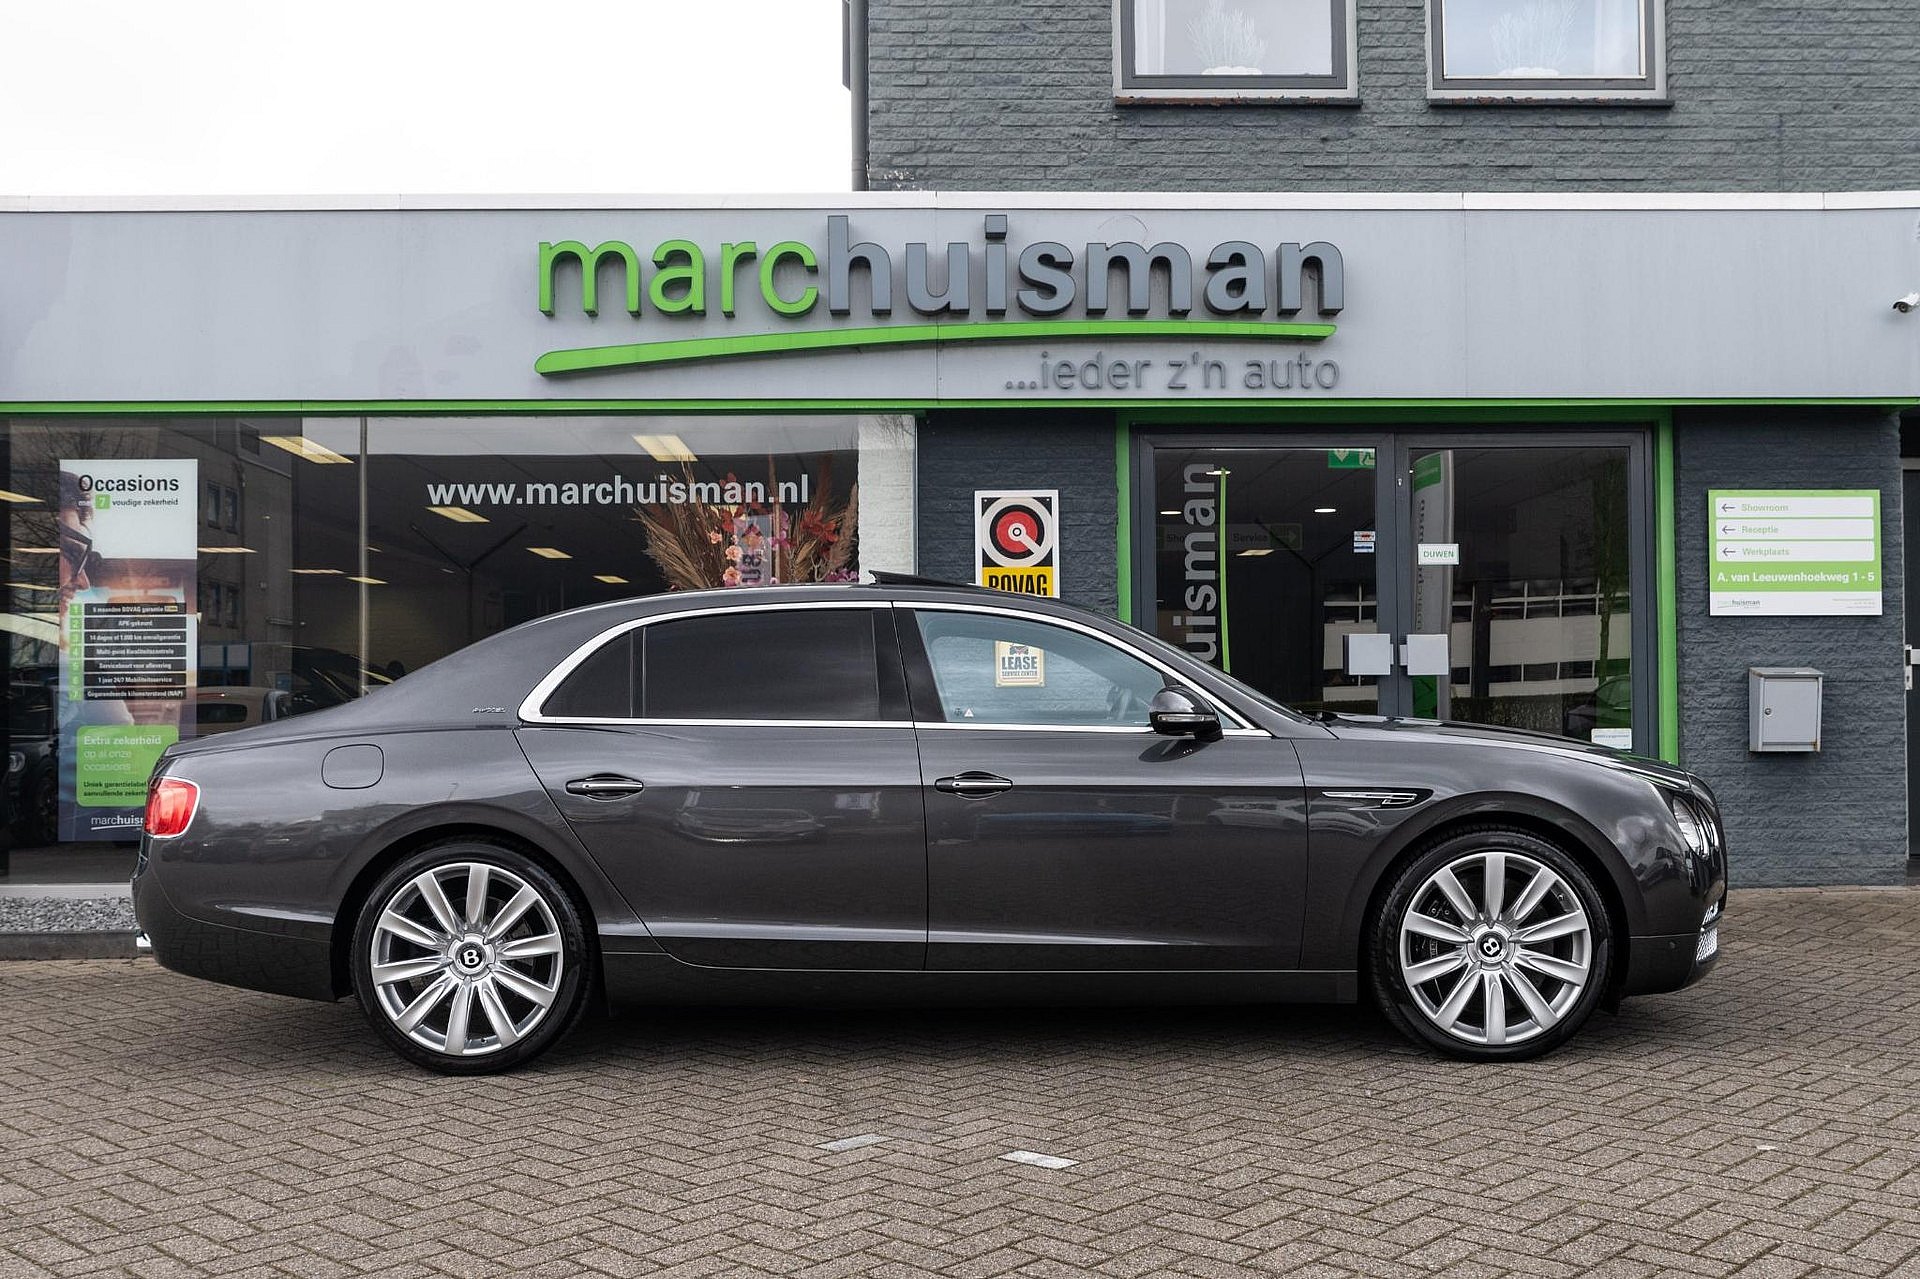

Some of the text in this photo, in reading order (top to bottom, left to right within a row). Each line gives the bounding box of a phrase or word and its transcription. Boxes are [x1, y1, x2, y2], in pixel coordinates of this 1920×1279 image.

[539, 215, 1344, 317] marchuisman
[1005, 352, 1340, 390] ...ieder z'n auto
[79, 474, 180, 492] Occasions
[427, 474, 809, 505] www.marchuisman.nl
[112, 499, 142, 508] voudige
[143, 498, 179, 506] zekerheid
[1741, 504, 1789, 512] Showroom
[1741, 525, 1779, 535] Receptie
[1423, 550, 1455, 558] DUWEN
[1742, 547, 1790, 557] Werkplaats
[1717, 572, 1728, 582] A.
[1731, 573, 1750, 582] van
[1752, 571, 1850, 584] Leeuwenhoekweg
[1852, 572, 1858, 582] 1
[1867, 572, 1875, 582] 5
[1001, 656, 1038, 670] LEASE
[83, 735, 161, 745] Extra zekerheid
[84, 763, 131, 771] occasions
[1483, 937, 1500, 956] B
[463, 949, 481, 966] B
